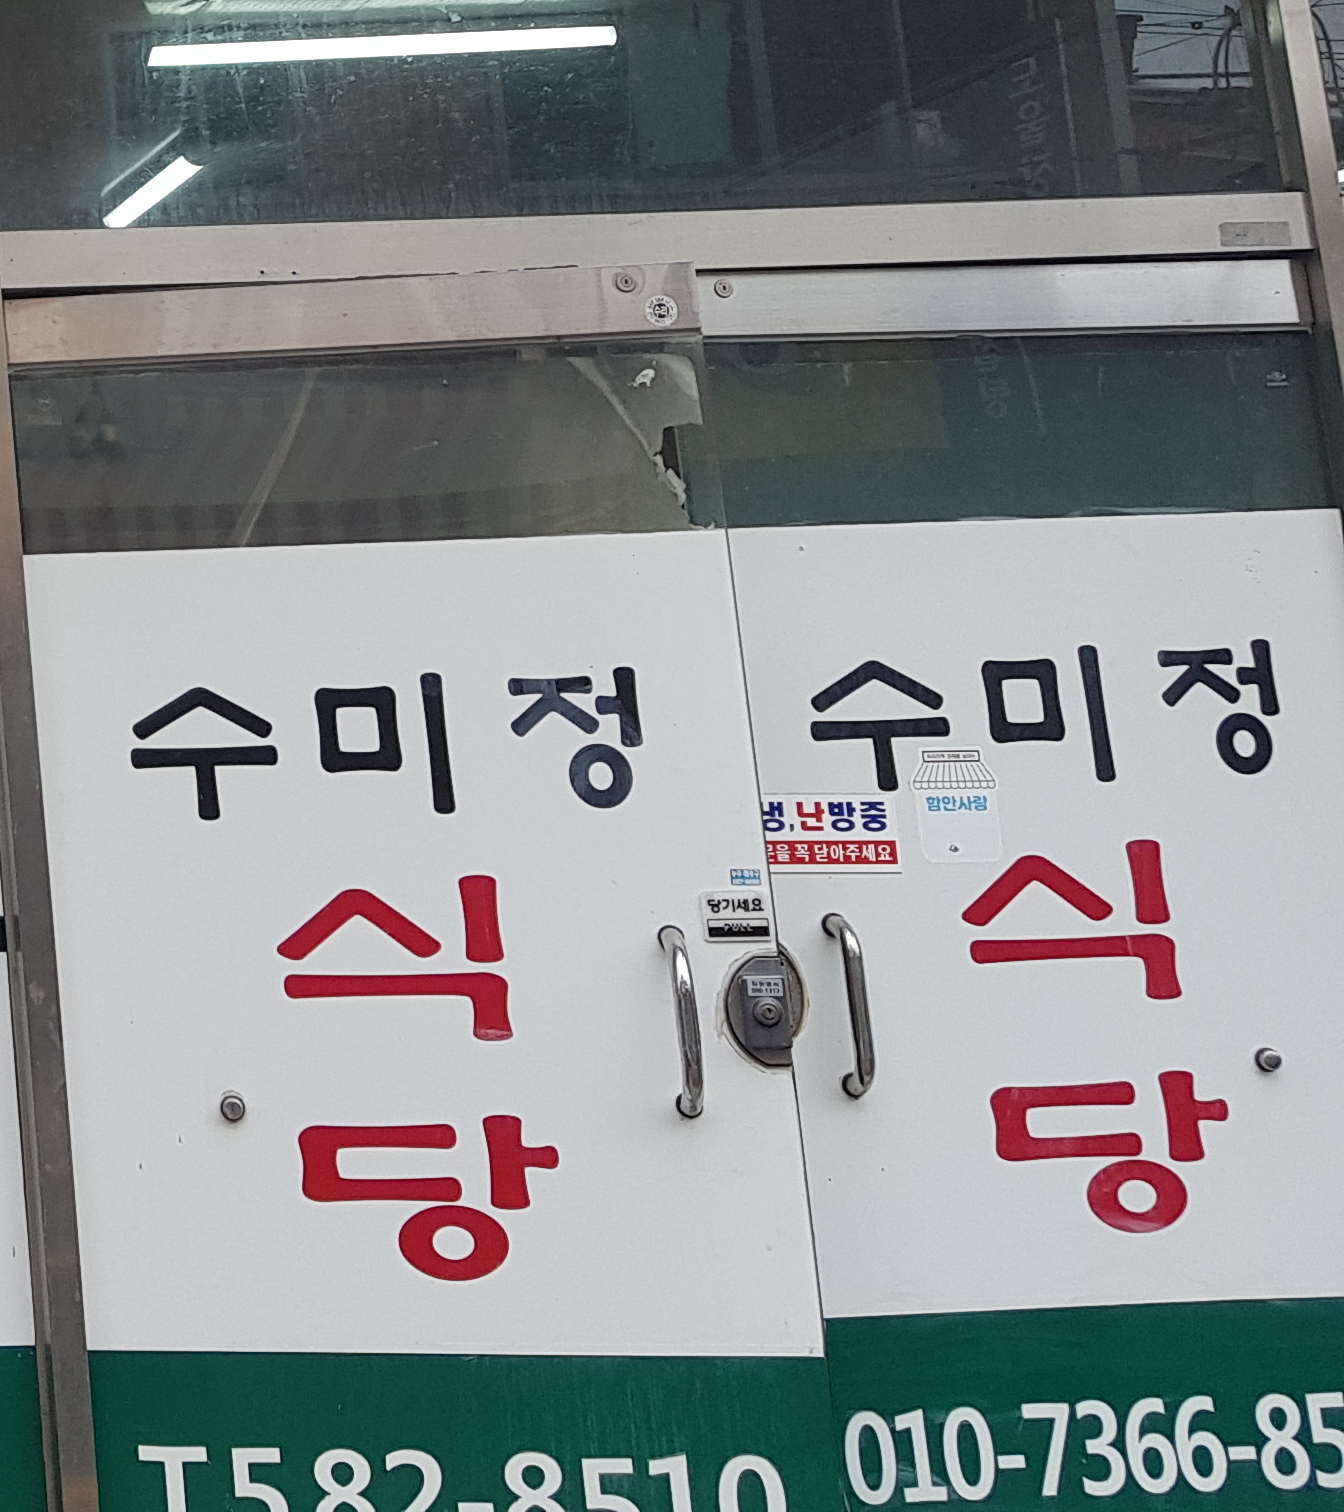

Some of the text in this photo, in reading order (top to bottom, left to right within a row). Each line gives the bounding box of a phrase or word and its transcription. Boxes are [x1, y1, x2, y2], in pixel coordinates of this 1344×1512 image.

[130, 666, 645, 822] 수미정
[811, 639, 1281, 792] 수미정
[794, 843, 811, 862] 꼭
[813, 843, 894, 862] 닫아주세요
[925, 795, 989, 813] 함안사랑
[707, 898, 765, 914] 당기세요
[723, 922, 754, 933] PULL
[276, 875, 560, 1282] 식당
[961, 839, 1230, 1234] 식당
[844, 1391, 1344, 1506] 010-7366-85
